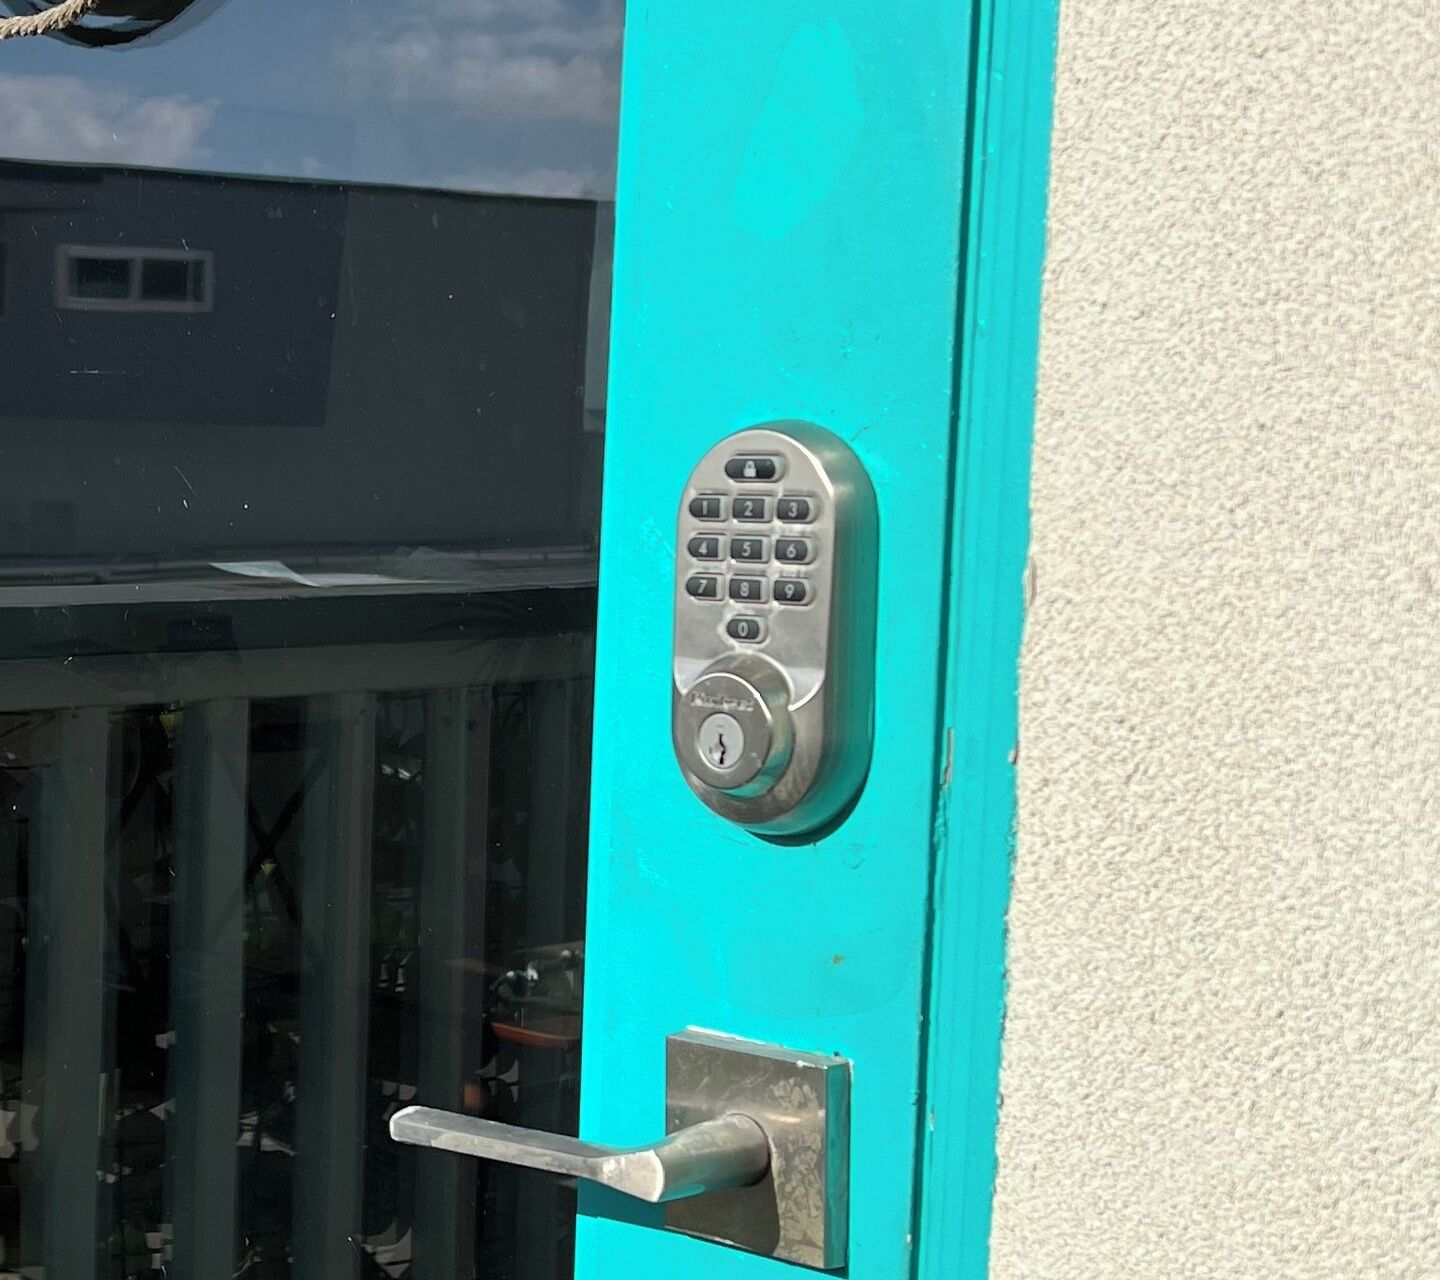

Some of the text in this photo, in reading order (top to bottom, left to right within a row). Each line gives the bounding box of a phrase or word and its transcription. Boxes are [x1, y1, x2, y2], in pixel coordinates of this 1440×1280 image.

[700, 500, 798, 518] 1 2 3
[698, 541, 797, 558] 4 5 6
[697, 579, 795, 598] 7 8 9
[738, 622, 748, 636] 0
